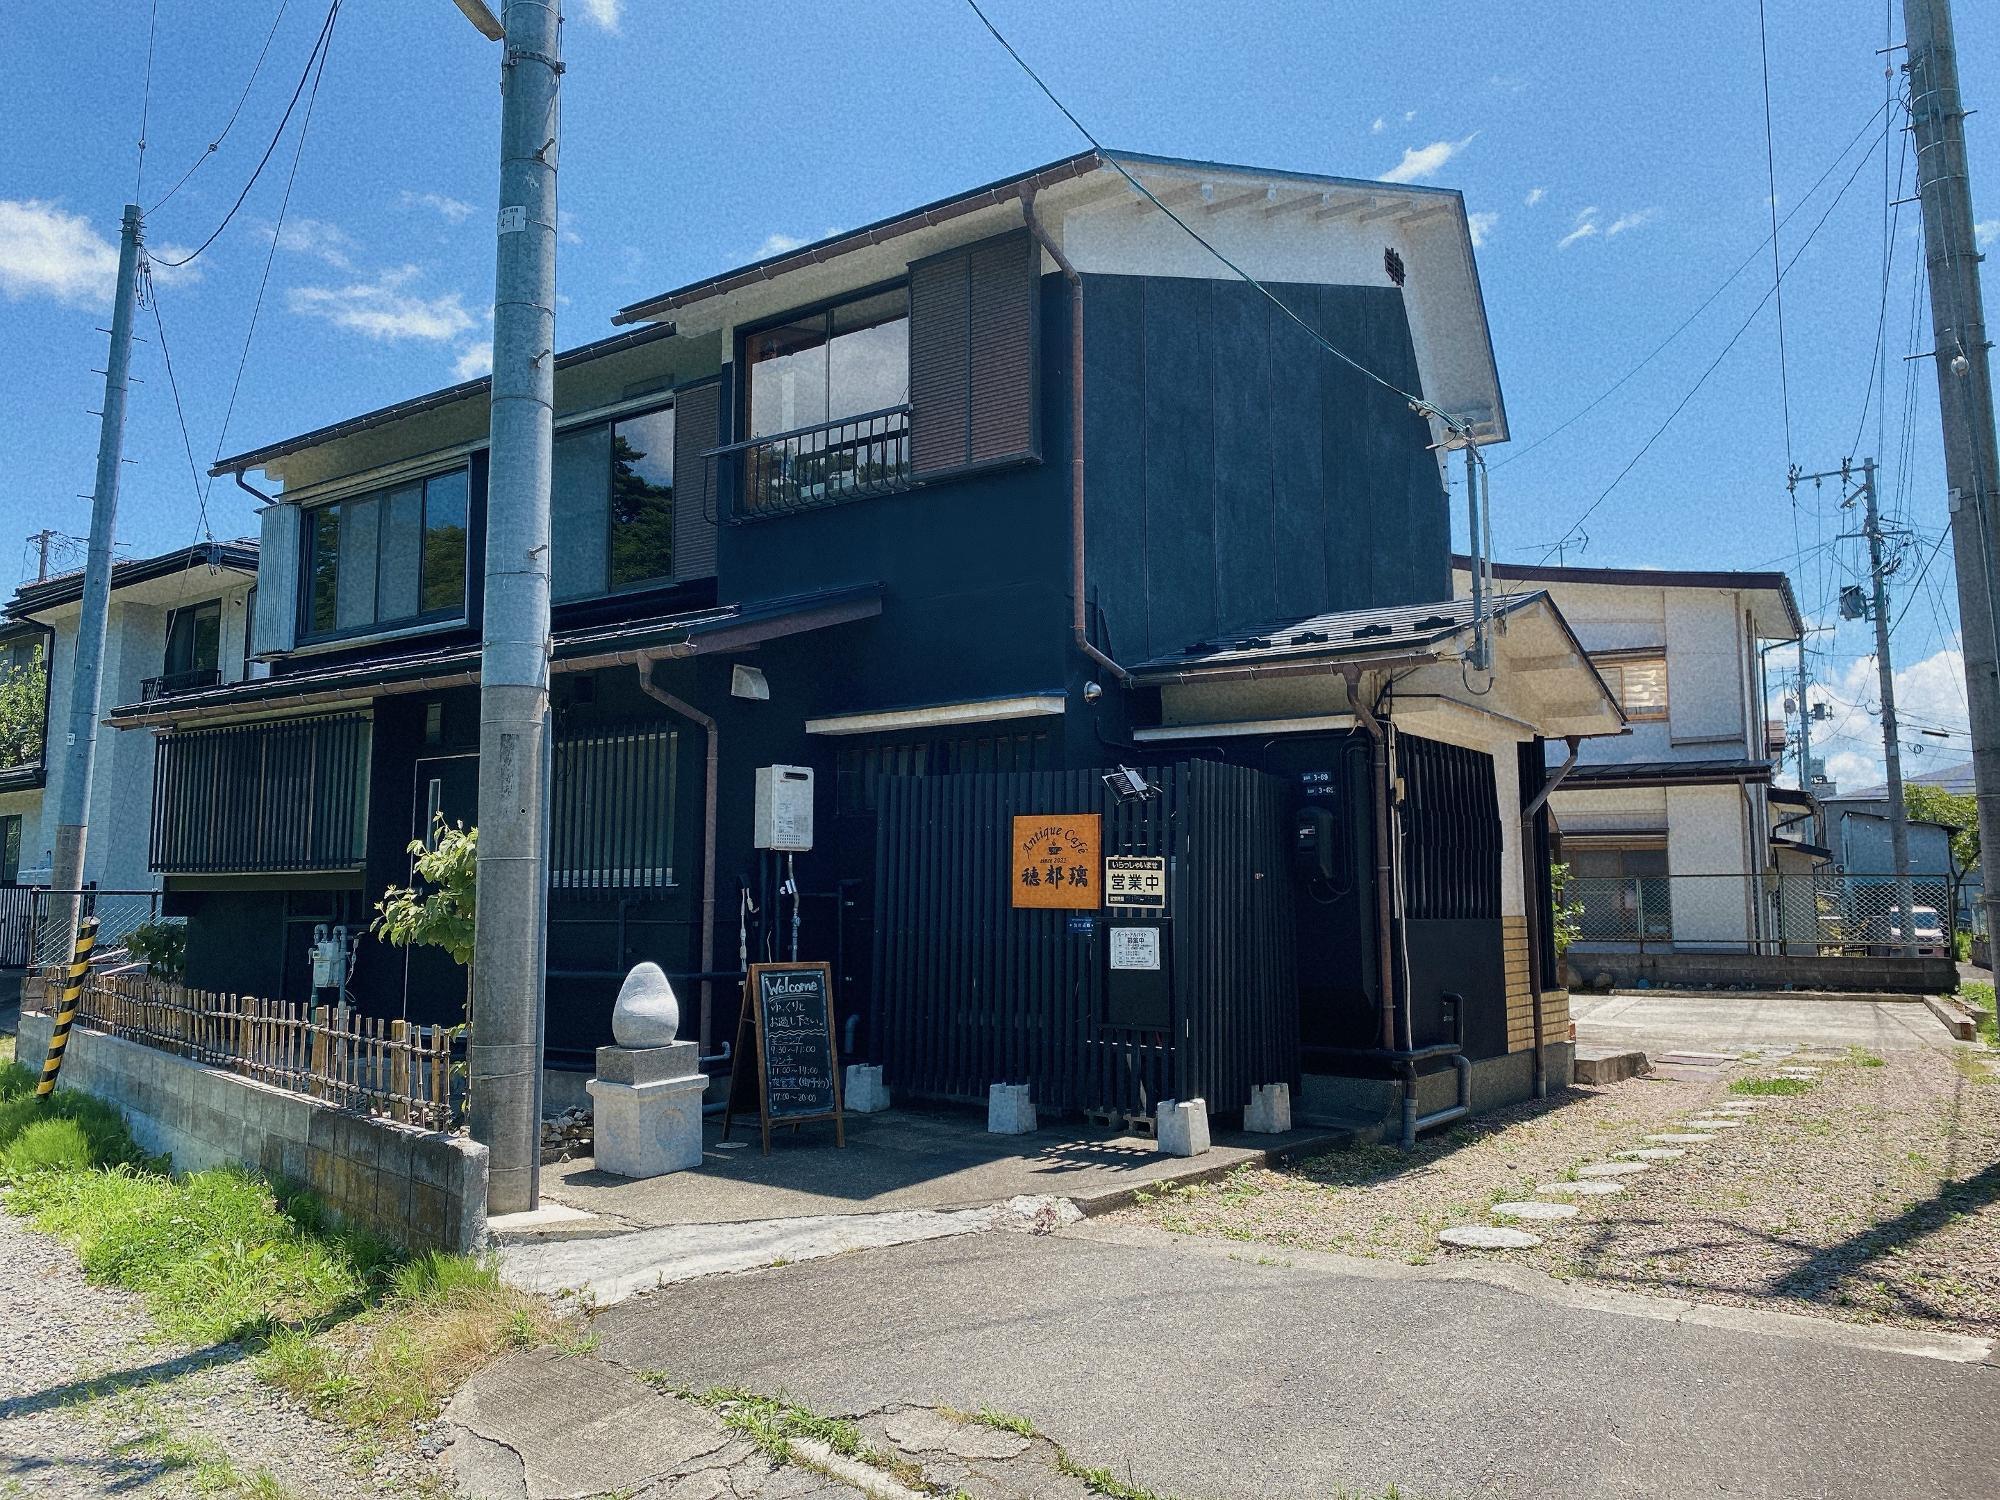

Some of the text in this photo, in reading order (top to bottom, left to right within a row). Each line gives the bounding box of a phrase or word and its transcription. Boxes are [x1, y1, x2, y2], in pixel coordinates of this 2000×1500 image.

[1022, 827, 1063, 861] Antique
[1112, 861, 1158, 869] いらっしゃいませ
[1111, 873, 1159, 891] 営業中
[766, 976, 818, 995] Welcome
